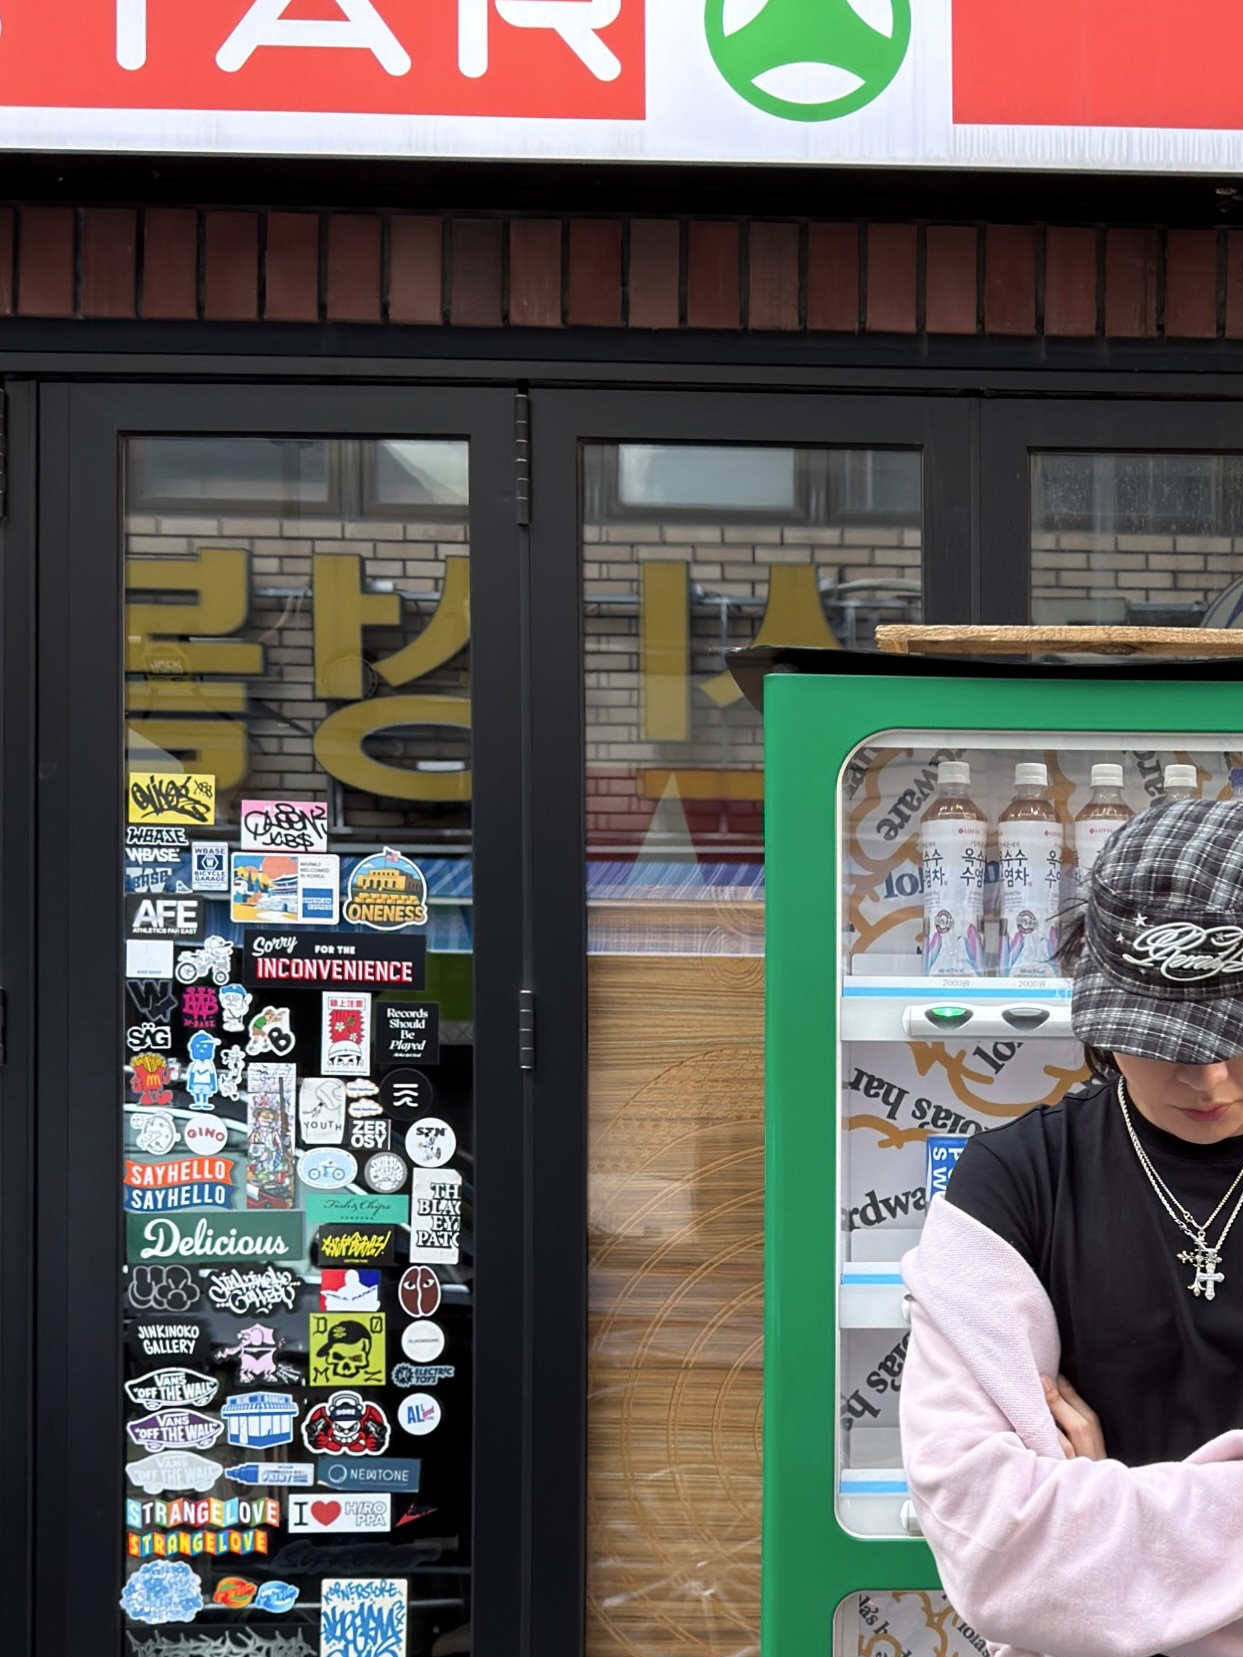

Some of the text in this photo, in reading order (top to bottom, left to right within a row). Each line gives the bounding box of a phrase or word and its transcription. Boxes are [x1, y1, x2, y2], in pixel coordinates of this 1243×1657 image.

[132, 899, 198, 928] AFE
[349, 904, 425, 923] ONENESS
[132, 927, 167, 935] ATHLETICS
[252, 936, 356, 957] Sorry FOR THE
[256, 957, 414, 983] INCONVENIENCE
[942, 979, 971, 987] 2000원
[1018, 980, 1047, 988] 2000원
[387, 1008, 428, 1018] Records
[389, 1019, 426, 1029] Should
[400, 1030, 416, 1040] Be
[389, 1039, 427, 1052] Played
[303, 1120, 342, 1131] YOUTH
[353, 1121, 387, 1134] ZER
[351, 1134, 387, 1148] OSY
[131, 1160, 226, 1185] SAYHELLO
[131, 1185, 226, 1210] SAYHELLO
[140, 1217, 289, 1259] Delicious
[137, 1325, 200, 1339] JINKINOKO
[143, 1339, 196, 1355] GALLERY
[415, 1366, 453, 1377] ELECTRIC
[153, 1372, 188, 1386] VANS
[415, 1376, 438, 1384] TOYS
[161, 1386, 182, 1401] THE
[156, 1413, 190, 1427] VANS
[162, 1427, 184, 1442] THE
[155, 1456, 189, 1468] VANS
[127, 1499, 279, 1527] STRANGELOVE
[129, 1530, 268, 1555] STRANGELOVE
